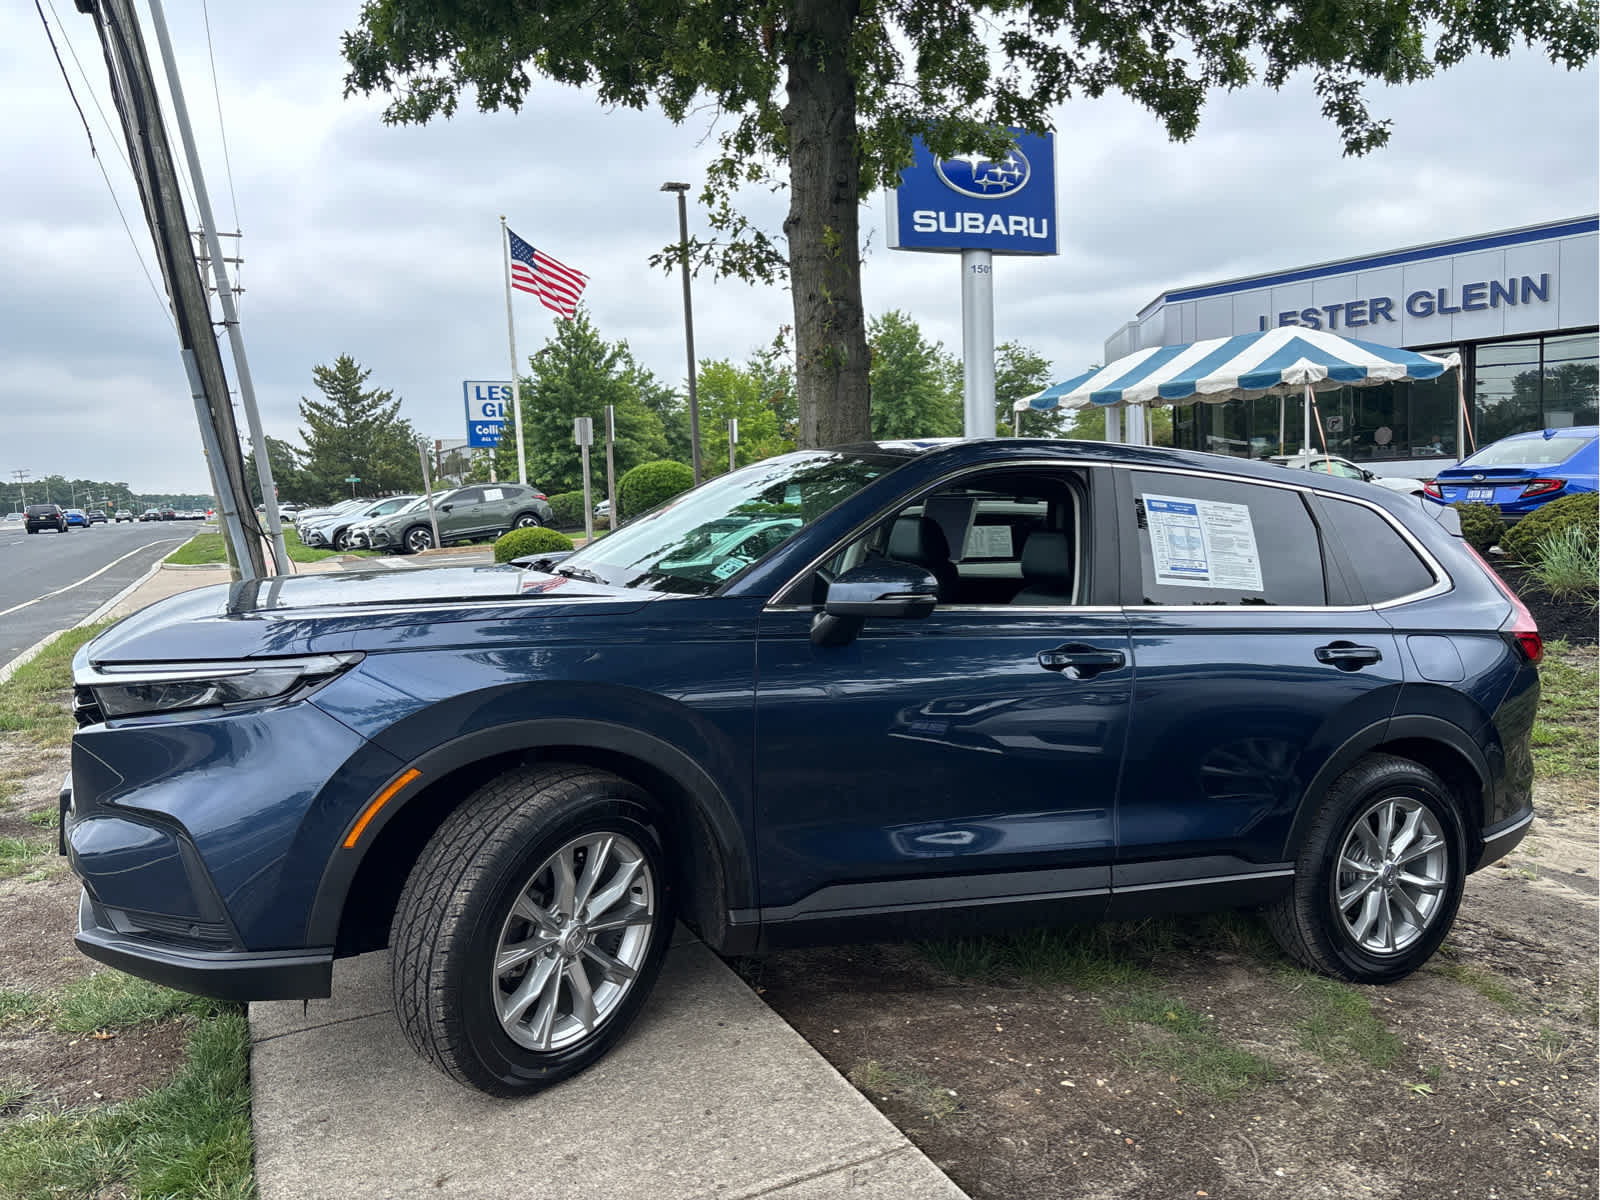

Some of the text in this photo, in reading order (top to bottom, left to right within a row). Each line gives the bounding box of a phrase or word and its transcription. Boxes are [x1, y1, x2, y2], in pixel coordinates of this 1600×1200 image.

[913, 210, 1048, 239] SUBARU
[1406, 273, 1549, 317] GLENN
[475, 385, 513, 400] LES
